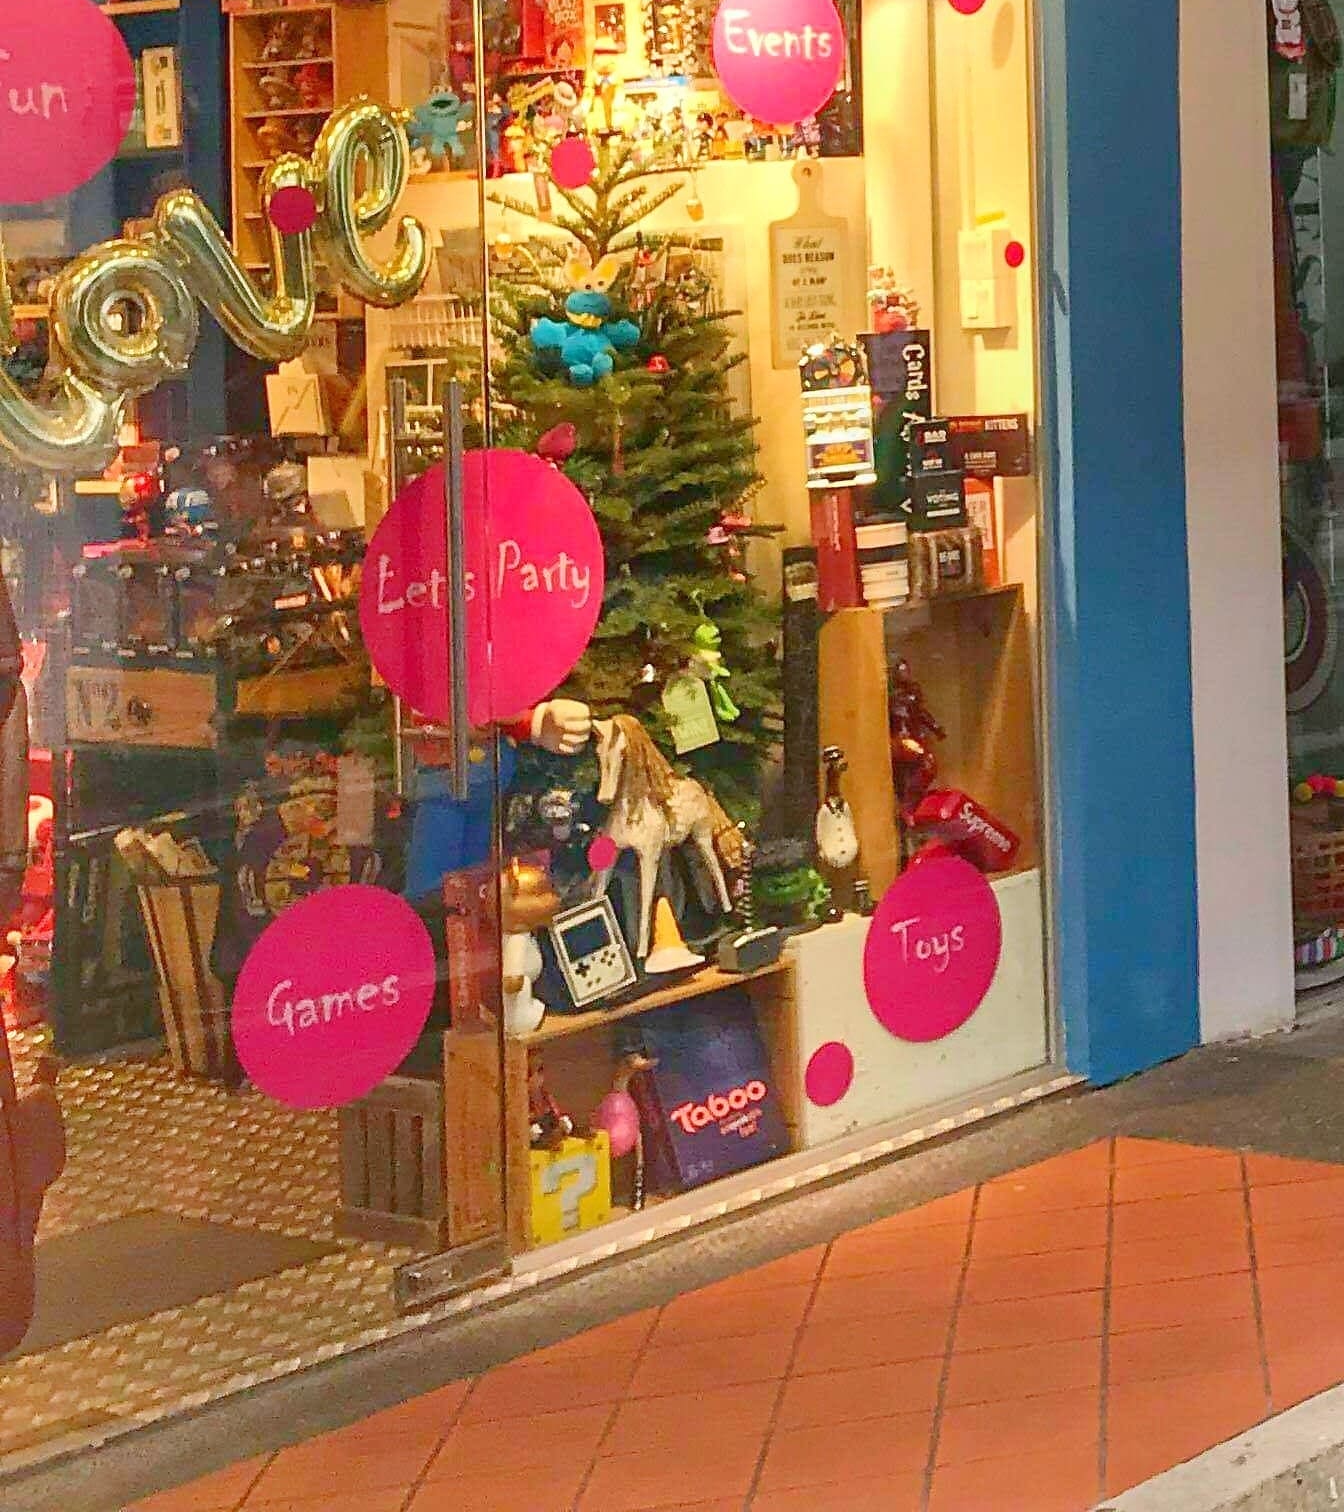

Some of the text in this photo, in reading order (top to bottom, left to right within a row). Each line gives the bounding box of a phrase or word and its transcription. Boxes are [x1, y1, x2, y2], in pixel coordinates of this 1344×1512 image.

[723, 9, 832, 60] Events
[0, 49, 67, 119] un
[902, 344, 927, 401] Cards
[378, 540, 590, 614] Lets Party
[959, 802, 1011, 853] Supreme
[890, 915, 964, 973] Toys
[268, 974, 400, 1036] Games
[670, 1079, 766, 1134] Taboo
